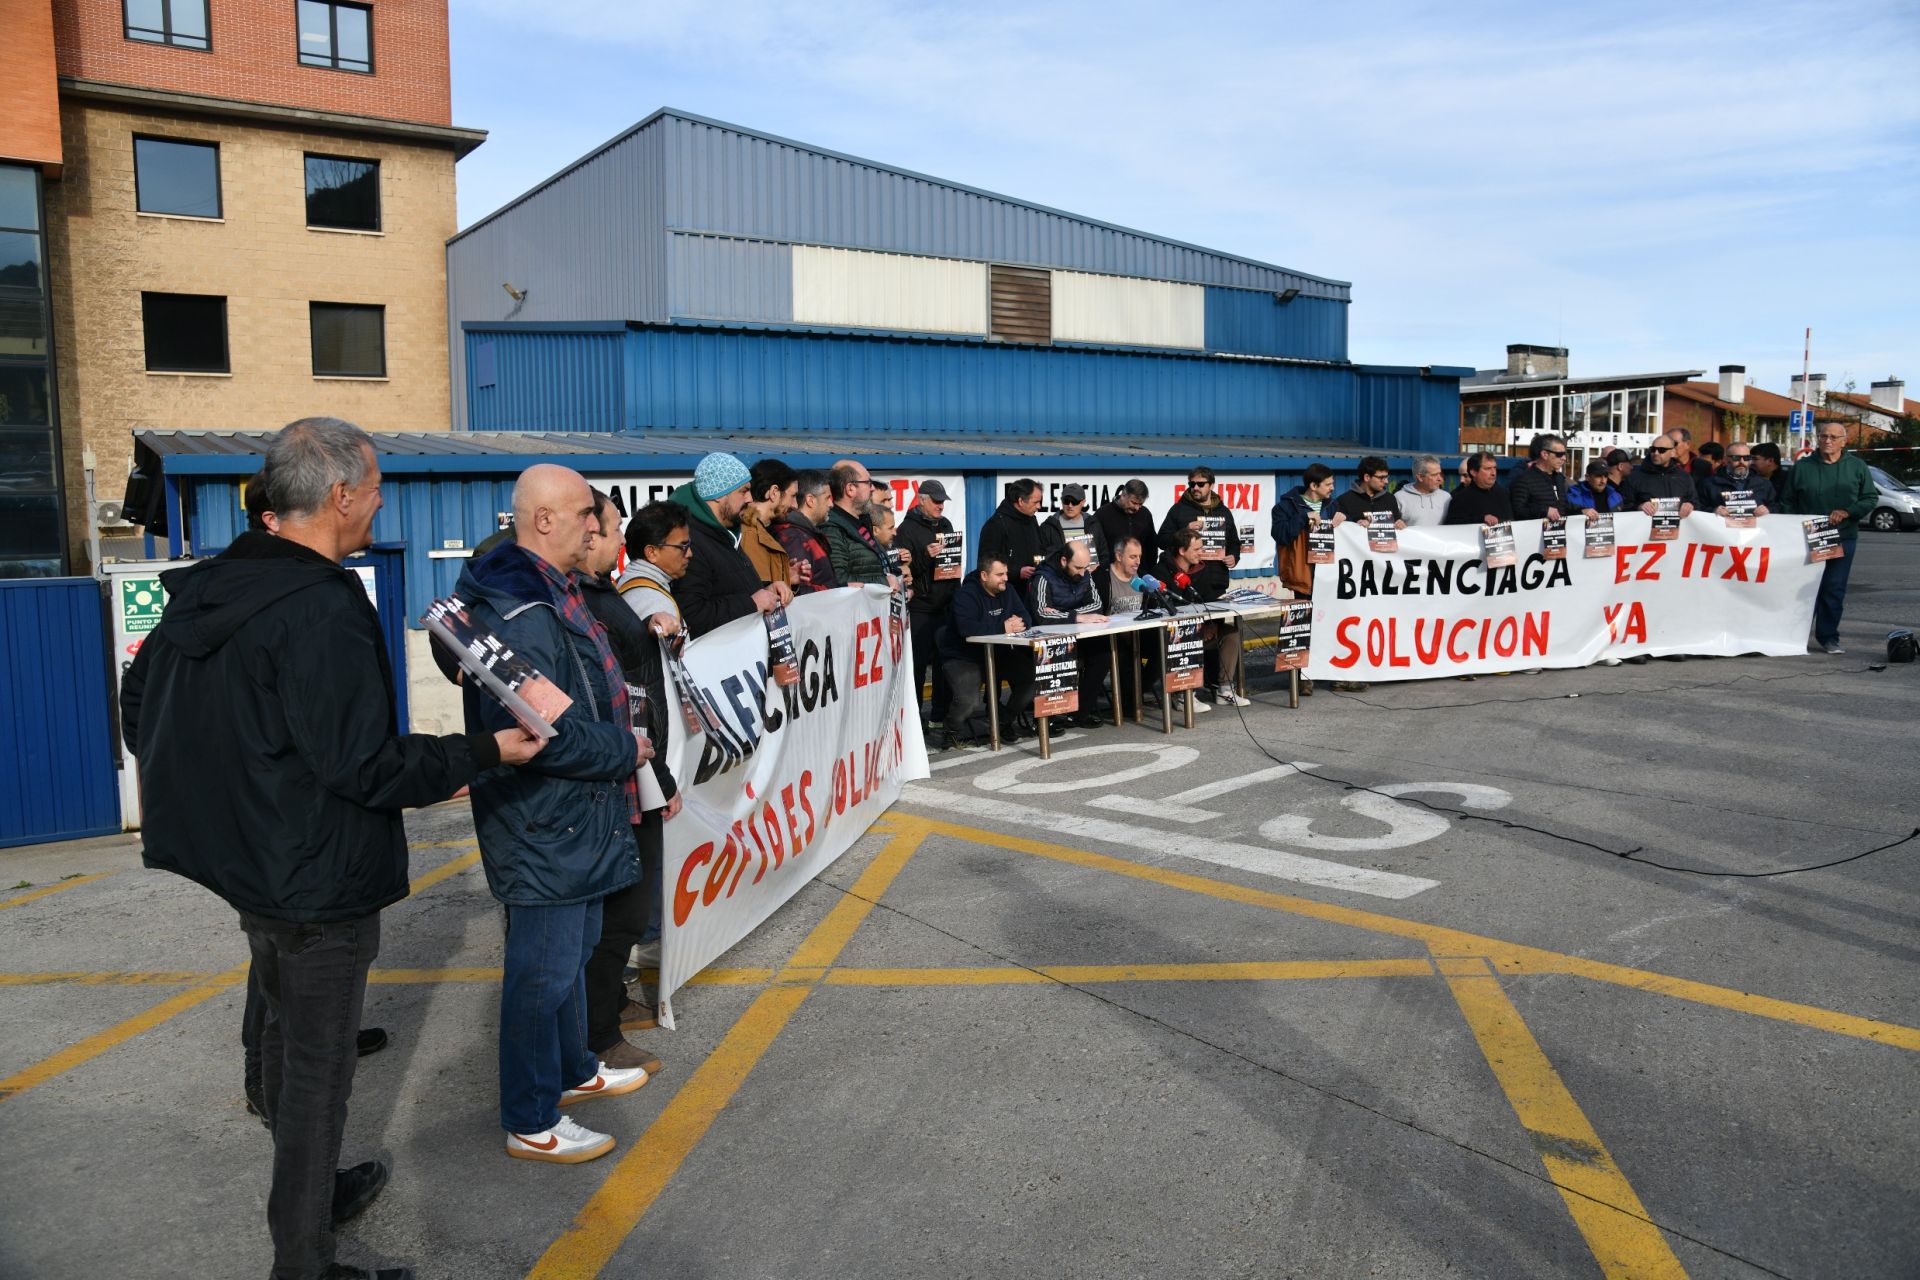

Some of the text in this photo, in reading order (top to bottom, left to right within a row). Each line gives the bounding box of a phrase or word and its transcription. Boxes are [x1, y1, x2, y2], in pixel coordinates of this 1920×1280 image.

[1218, 483, 1260, 512] ITXI
[1337, 542, 1771, 600] BALENCIAGA EZ ITXI
[1288, 639, 1298, 647] 29
[1329, 602, 1647, 669] SOLUCION YA
[854, 616, 883, 690] EZ
[1179, 657, 1190, 666] 29
[1049, 679, 1061, 688] 29
